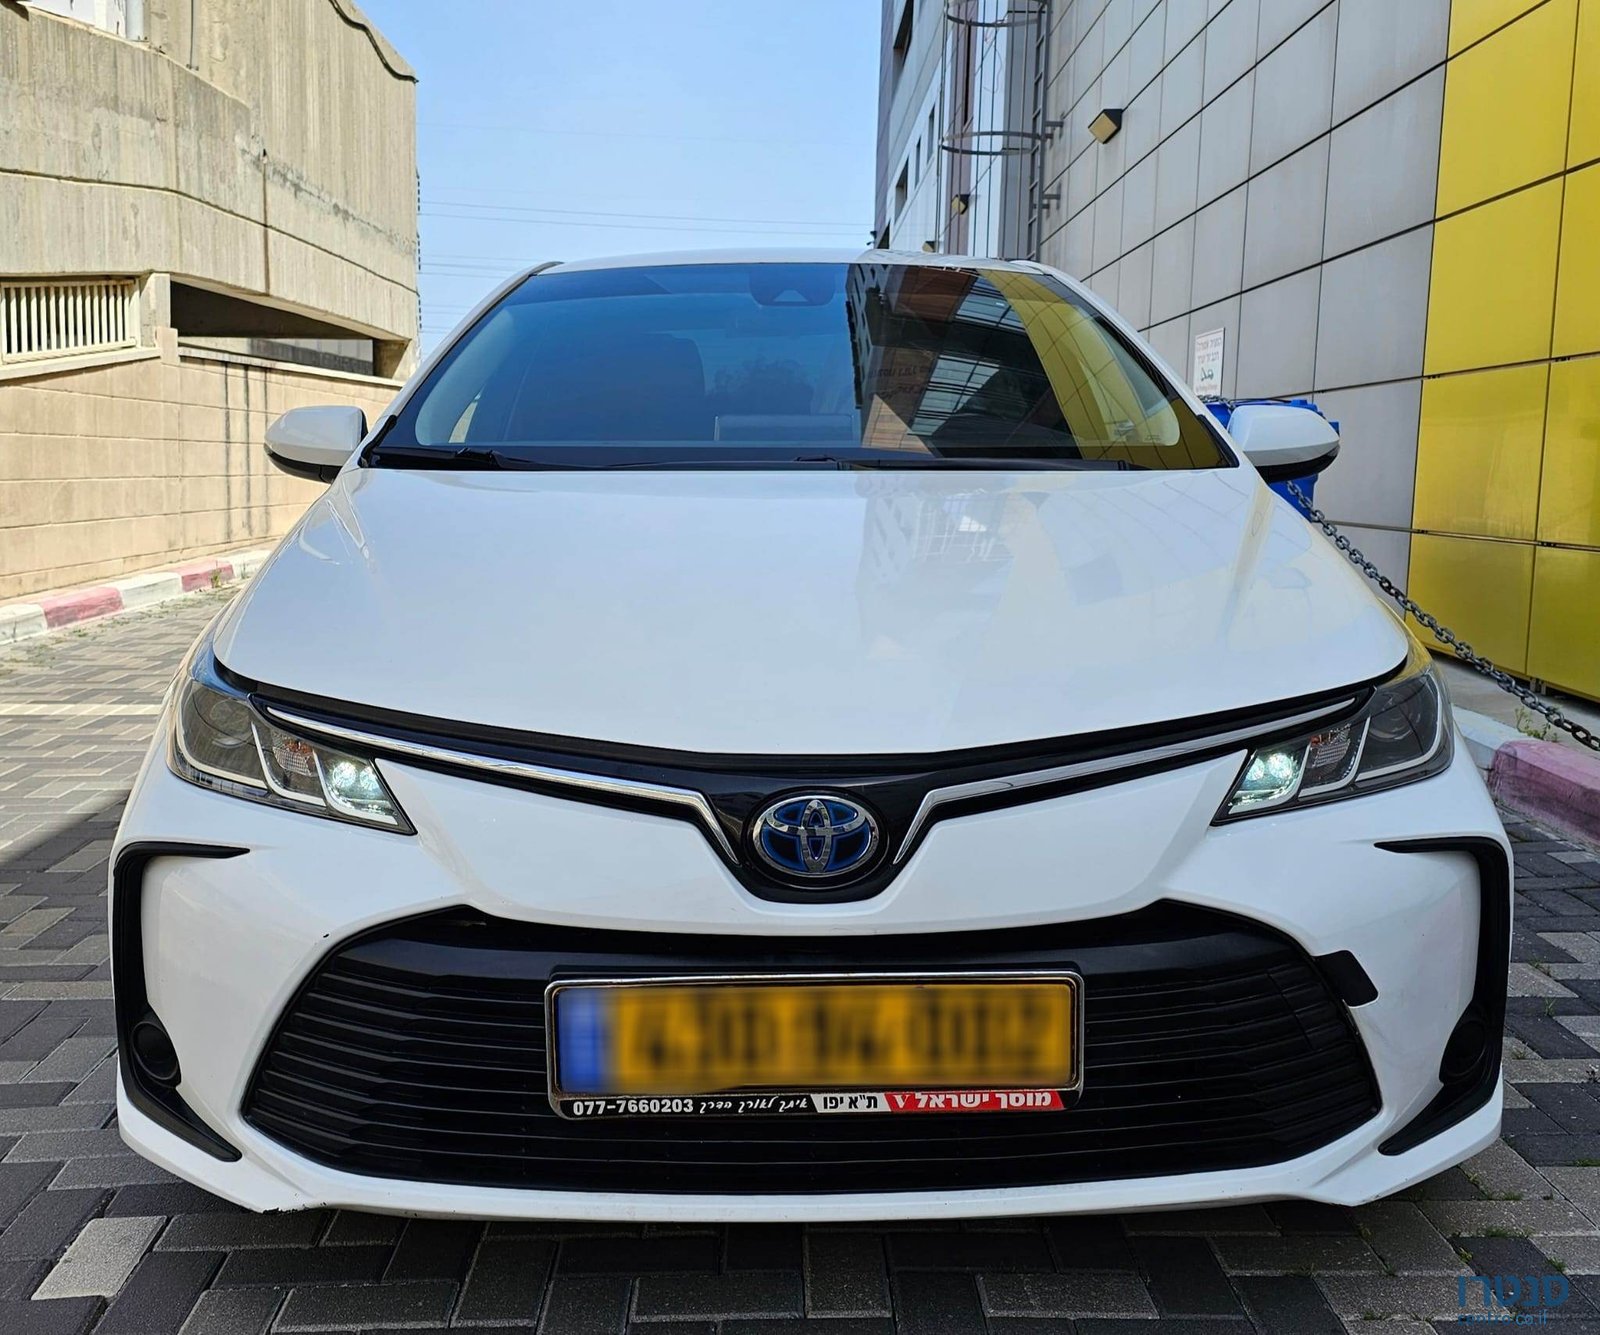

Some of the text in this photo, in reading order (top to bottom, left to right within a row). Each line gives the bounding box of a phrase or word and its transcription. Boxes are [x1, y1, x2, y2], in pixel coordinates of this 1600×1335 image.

[572, 1098, 694, 1116] 077-7660203
[699, 1099, 733, 1115] הדרך
[738, 1095, 779, 1114] לאורך
[823, 1095, 844, 1110] יפו
[914, 1091, 989, 1109] ישראל
[995, 1090, 1051, 1109] מוסך
